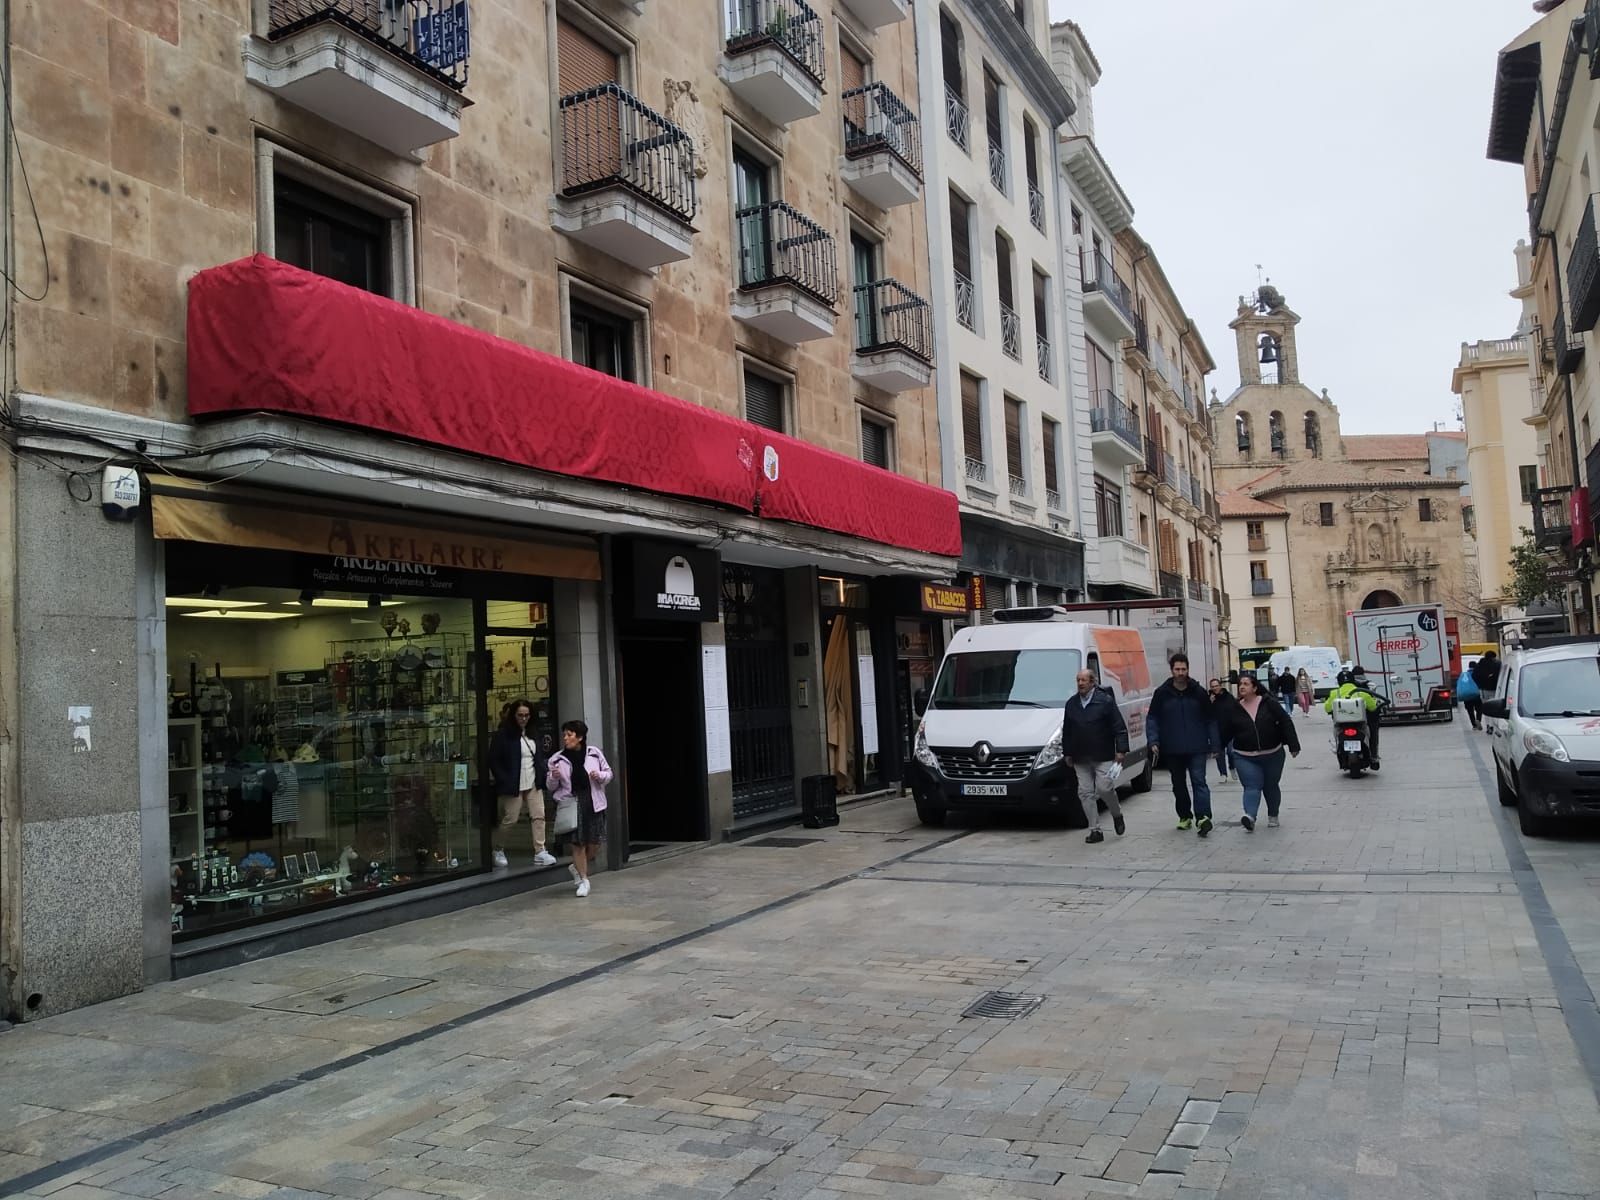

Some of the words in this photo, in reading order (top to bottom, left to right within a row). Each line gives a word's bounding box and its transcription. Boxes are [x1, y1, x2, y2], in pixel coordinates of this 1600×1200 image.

[328, 519, 504, 570] AKELARRE
[936, 590, 966, 608] TABACOS
[1376, 639, 1421, 652] FERRERO
[966, 785, 987, 794] 2935
[989, 785, 1006, 795] KVK
